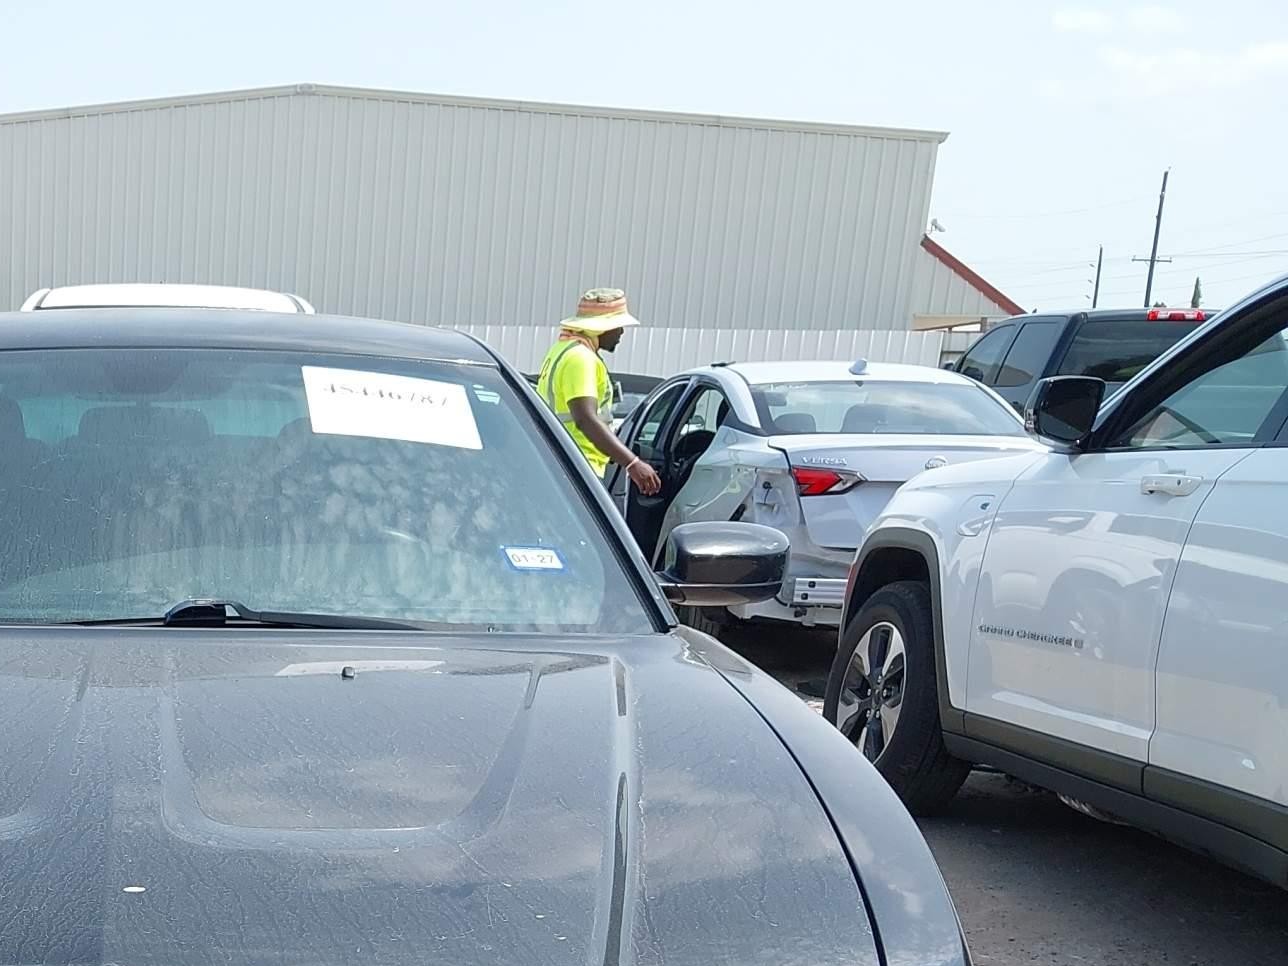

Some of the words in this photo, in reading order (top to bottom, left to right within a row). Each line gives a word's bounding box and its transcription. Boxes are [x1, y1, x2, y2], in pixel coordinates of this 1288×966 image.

[801, 456, 848, 466] VERSA
[978, 624, 1015, 638] GRAND
[1016, 629, 1073, 647] CHEROKEE
